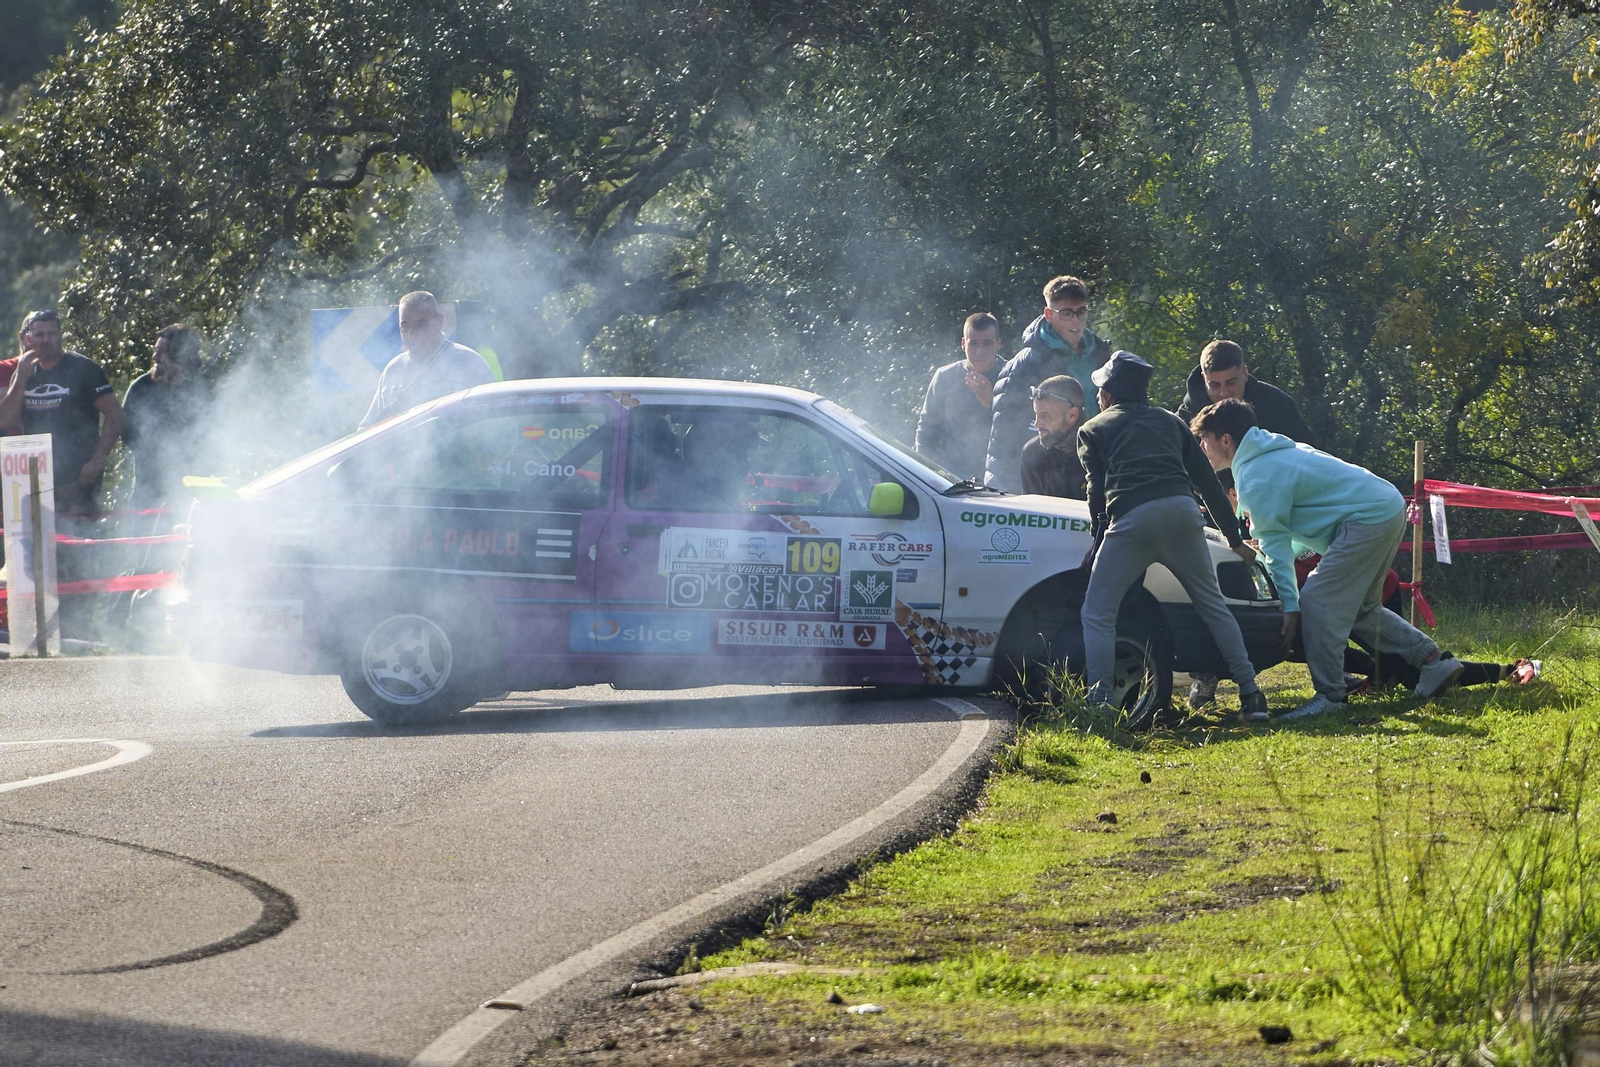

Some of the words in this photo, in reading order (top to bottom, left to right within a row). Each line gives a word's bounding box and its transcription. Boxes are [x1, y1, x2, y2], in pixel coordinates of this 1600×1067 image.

[25, 397, 62, 405] NAULTsport
[523, 460, 576, 476] Cano
[960, 510, 1091, 532] agroMEDITEX
[444, 528, 521, 556] PAOLO
[848, 542, 895, 552] RAFER
[898, 543, 933, 552] CARS
[788, 541, 840, 574] 109
[738, 564, 782, 574] Villacor
[705, 574, 833, 594] MORENO'S
[724, 591, 826, 611] CAPILAR
[622, 625, 692, 641] slice
[726, 621, 787, 636] SISUR
[726, 635, 770, 643] SISTEMAS
[788, 637, 844, 646] SEGURIDAD
